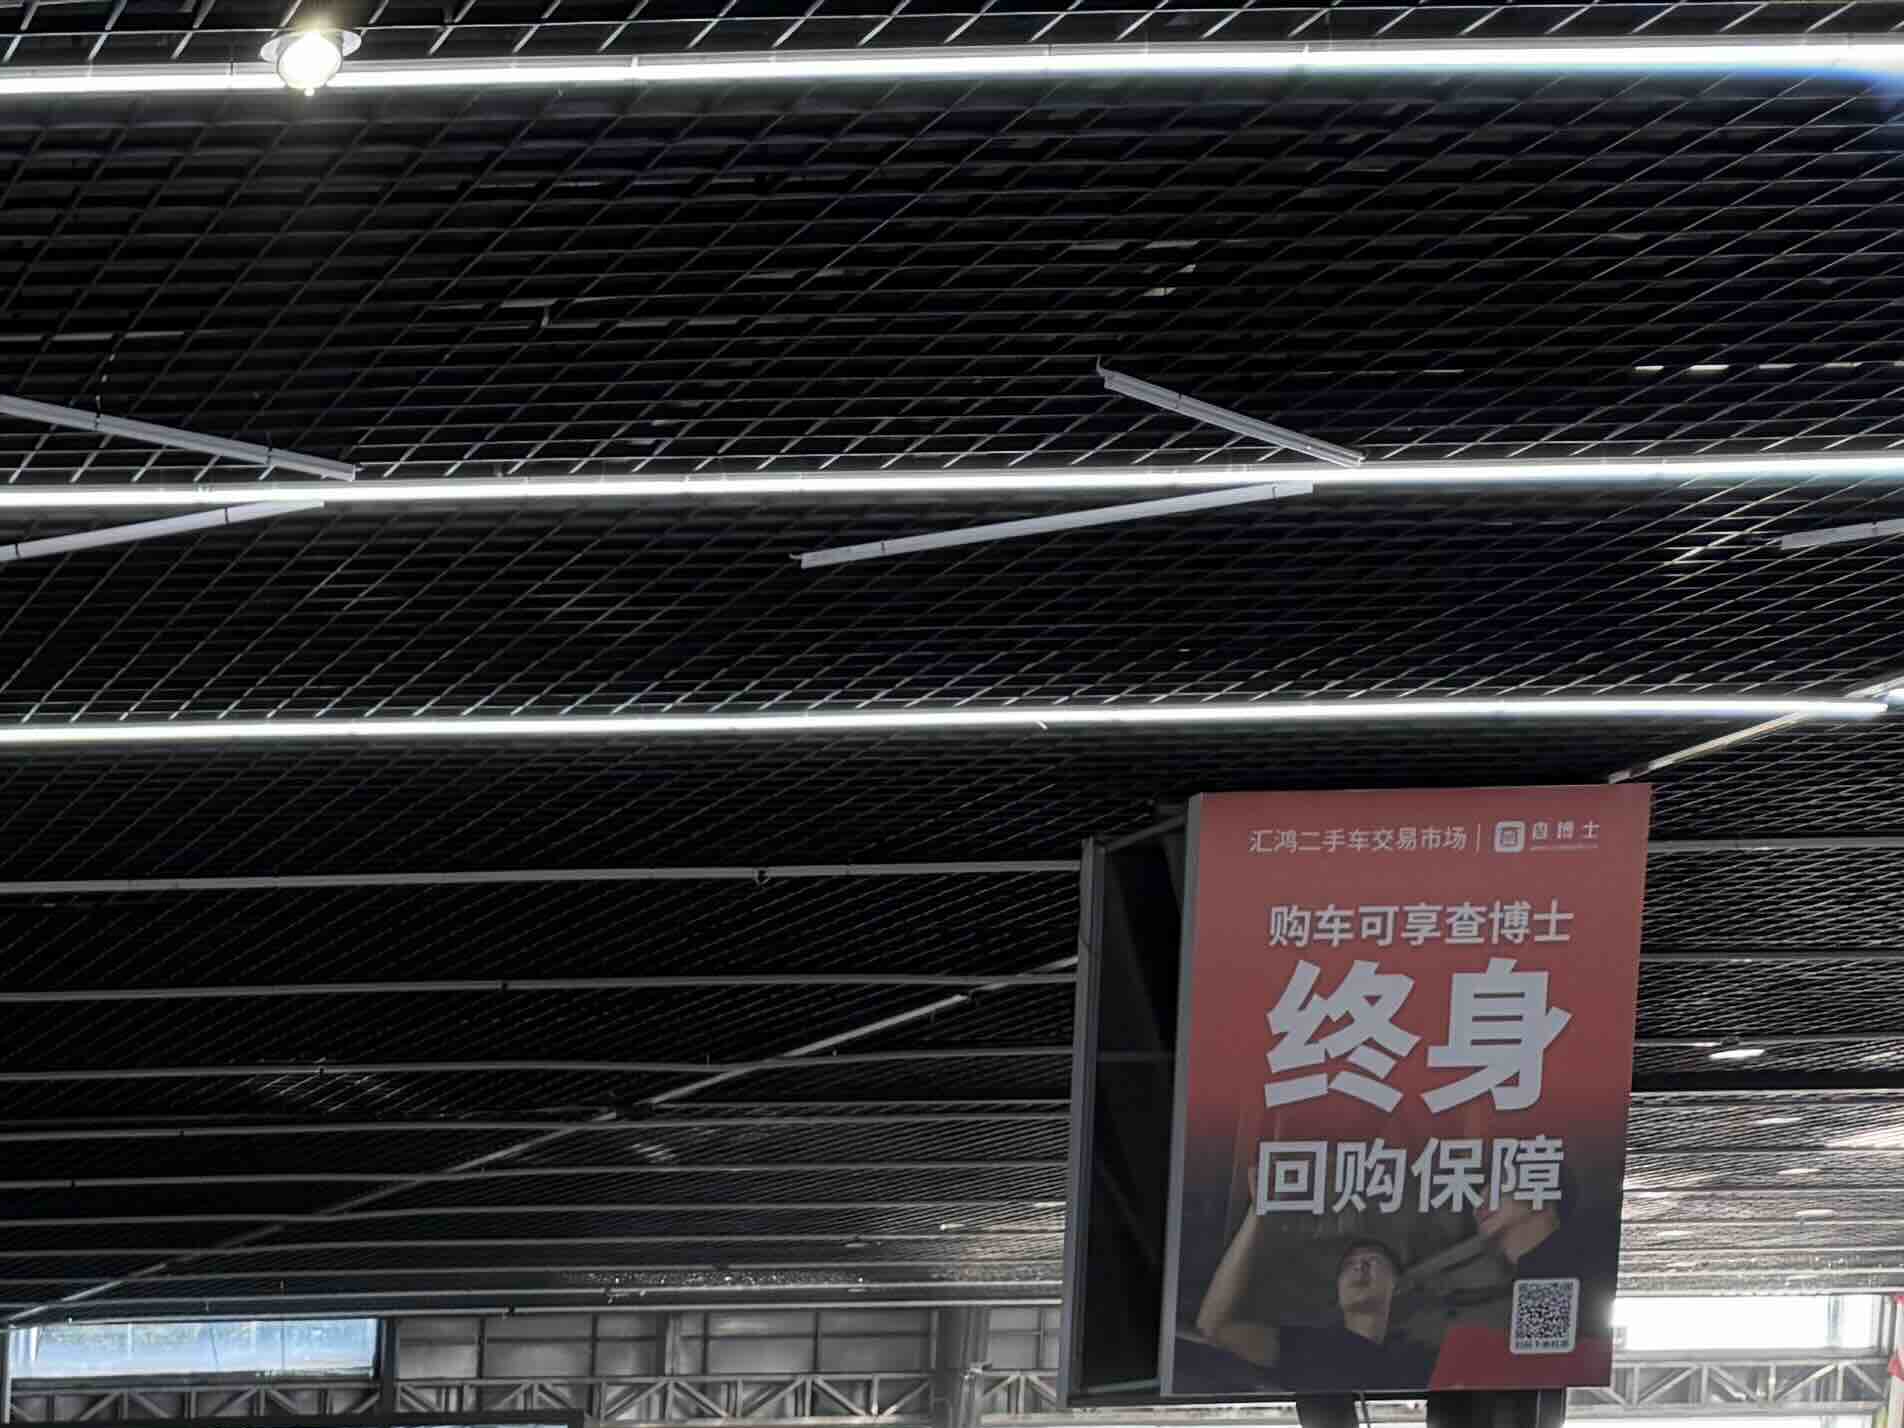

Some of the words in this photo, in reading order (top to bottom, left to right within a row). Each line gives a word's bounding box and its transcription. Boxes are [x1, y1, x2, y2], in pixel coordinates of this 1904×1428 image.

[1248, 826, 1467, 853] 汇鸿二手车交易市场
[1268, 900, 1575, 947] 购车可享查博士
[1264, 957, 1573, 1114] 终身
[1253, 1134, 1565, 1216] 回购保障
